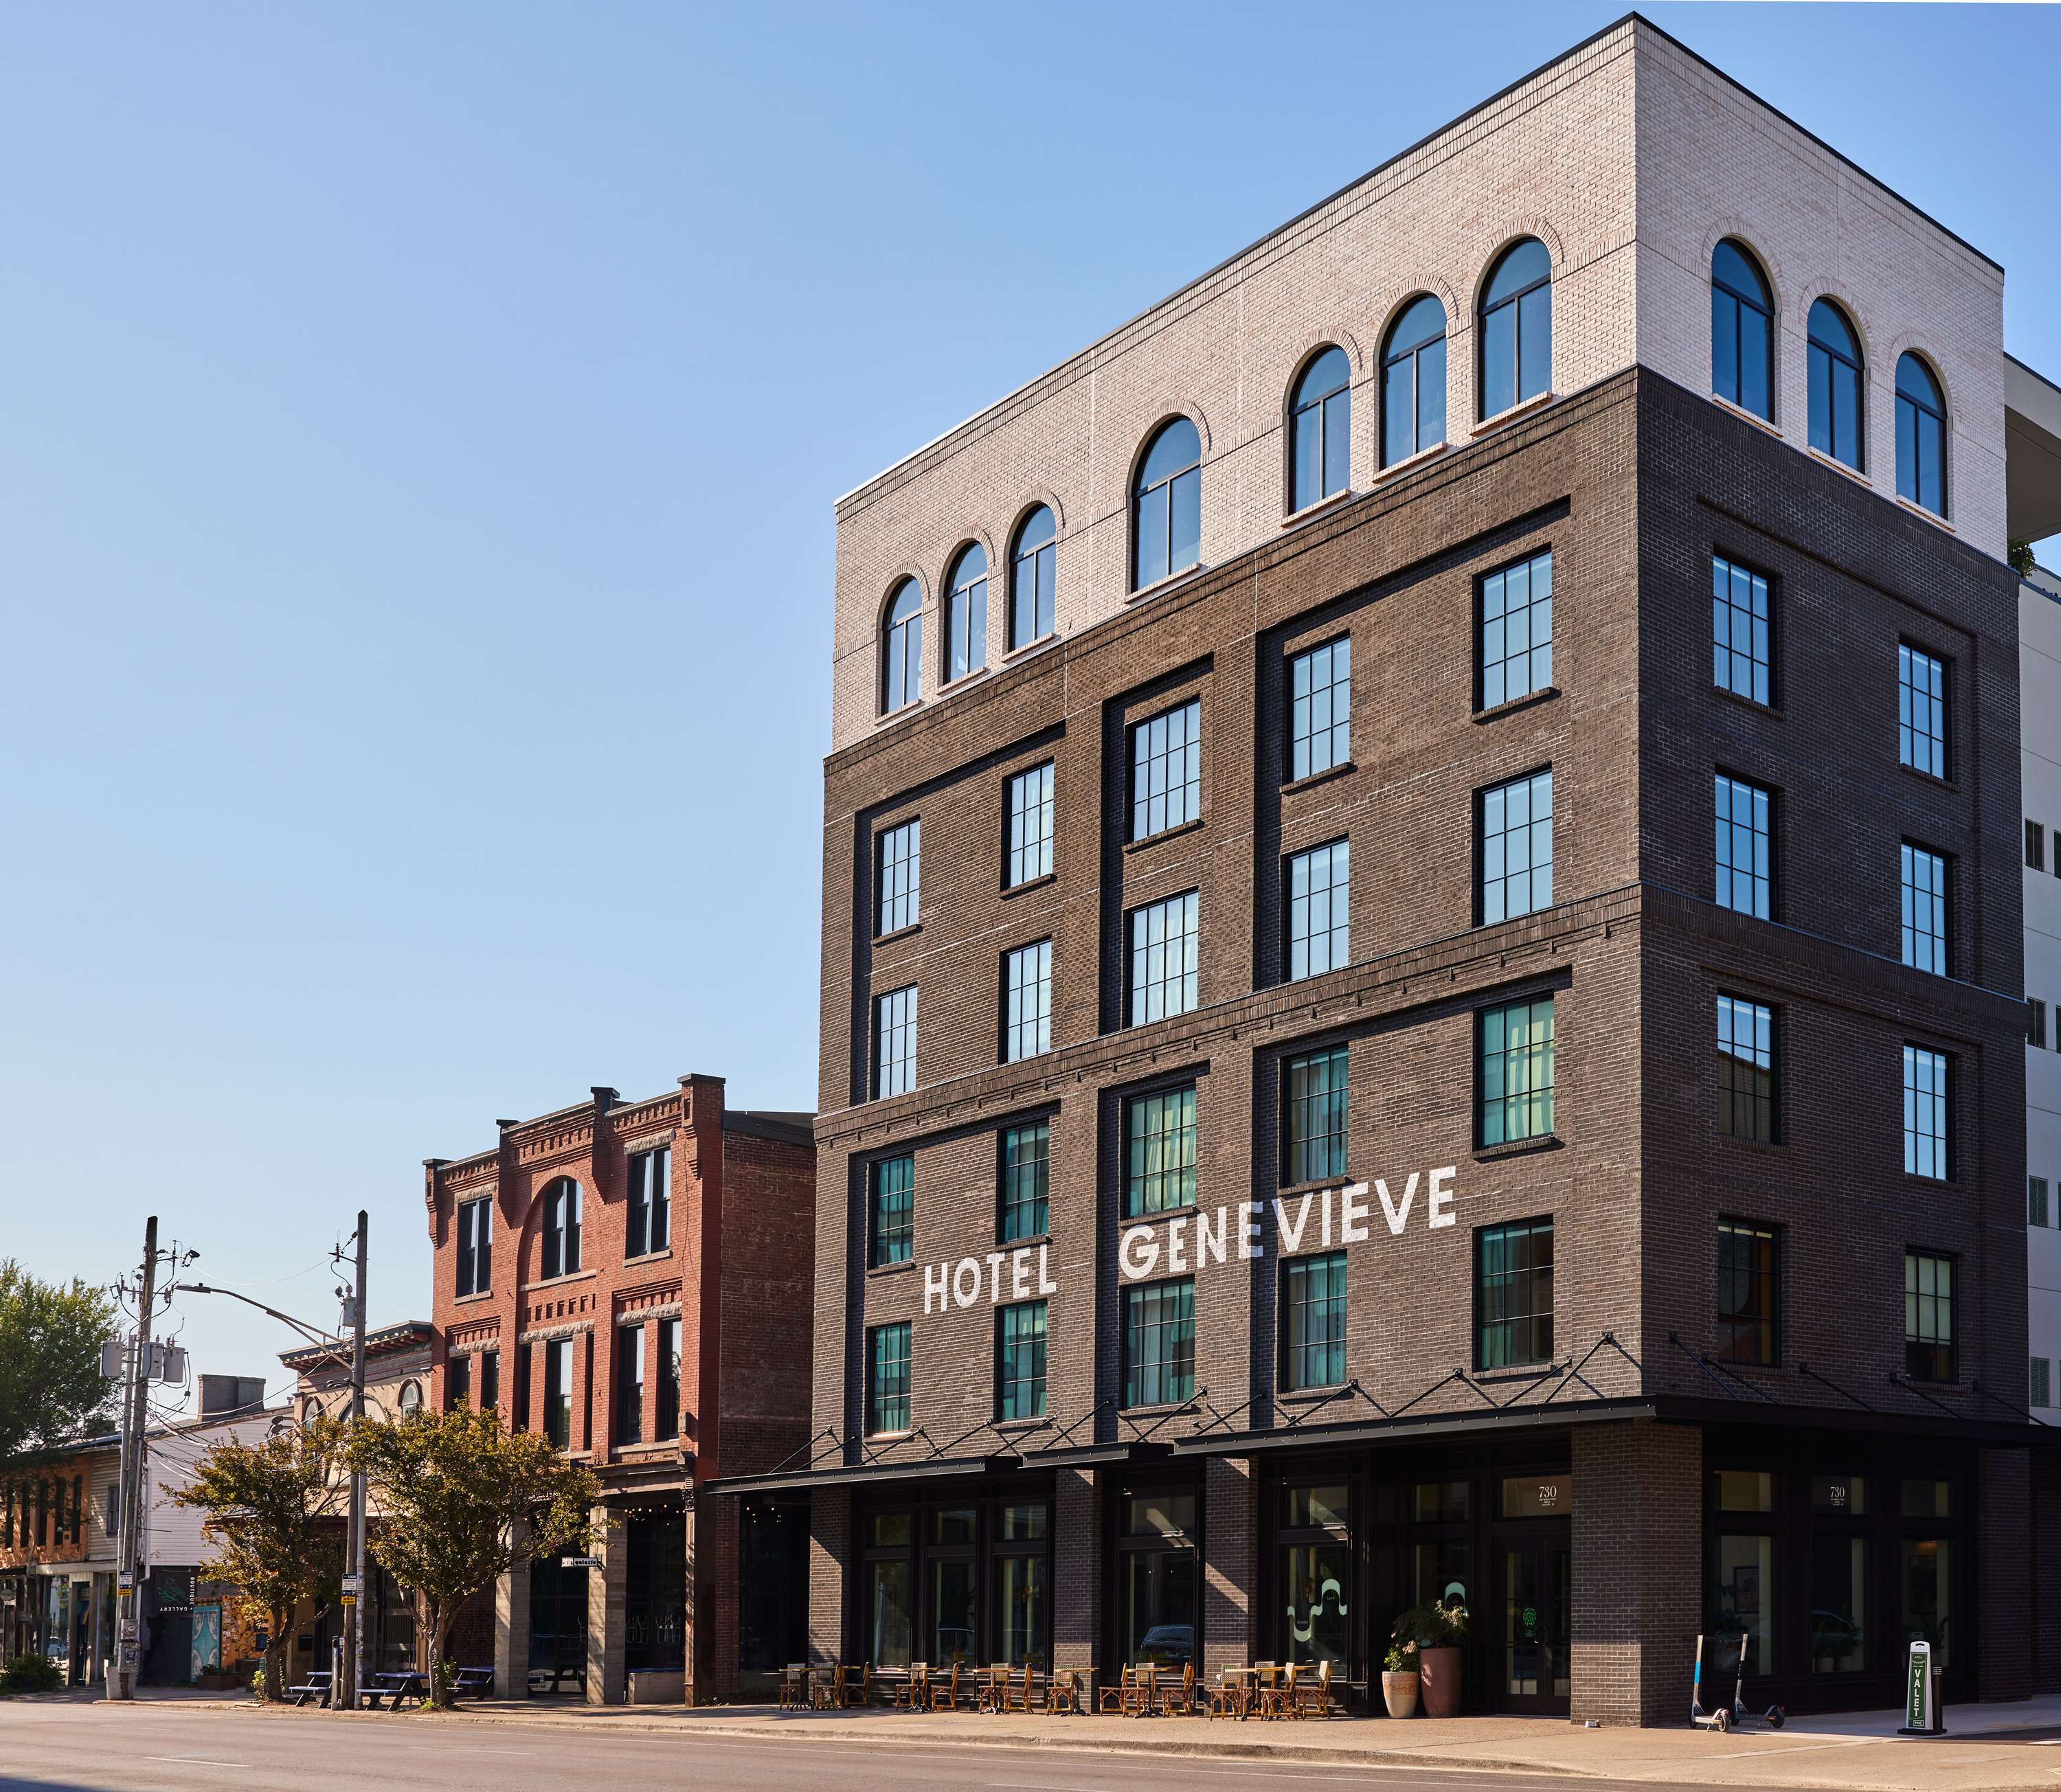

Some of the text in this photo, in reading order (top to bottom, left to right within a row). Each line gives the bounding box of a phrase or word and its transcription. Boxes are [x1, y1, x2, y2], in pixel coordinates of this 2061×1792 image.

[924, 1166, 1456, 1314] HOTEL GENEVIEVE
[1539, 1486, 1557, 1498] 730
[1830, 1486, 1845, 1498] 730
[1913, 1668, 1922, 1717] VALET
